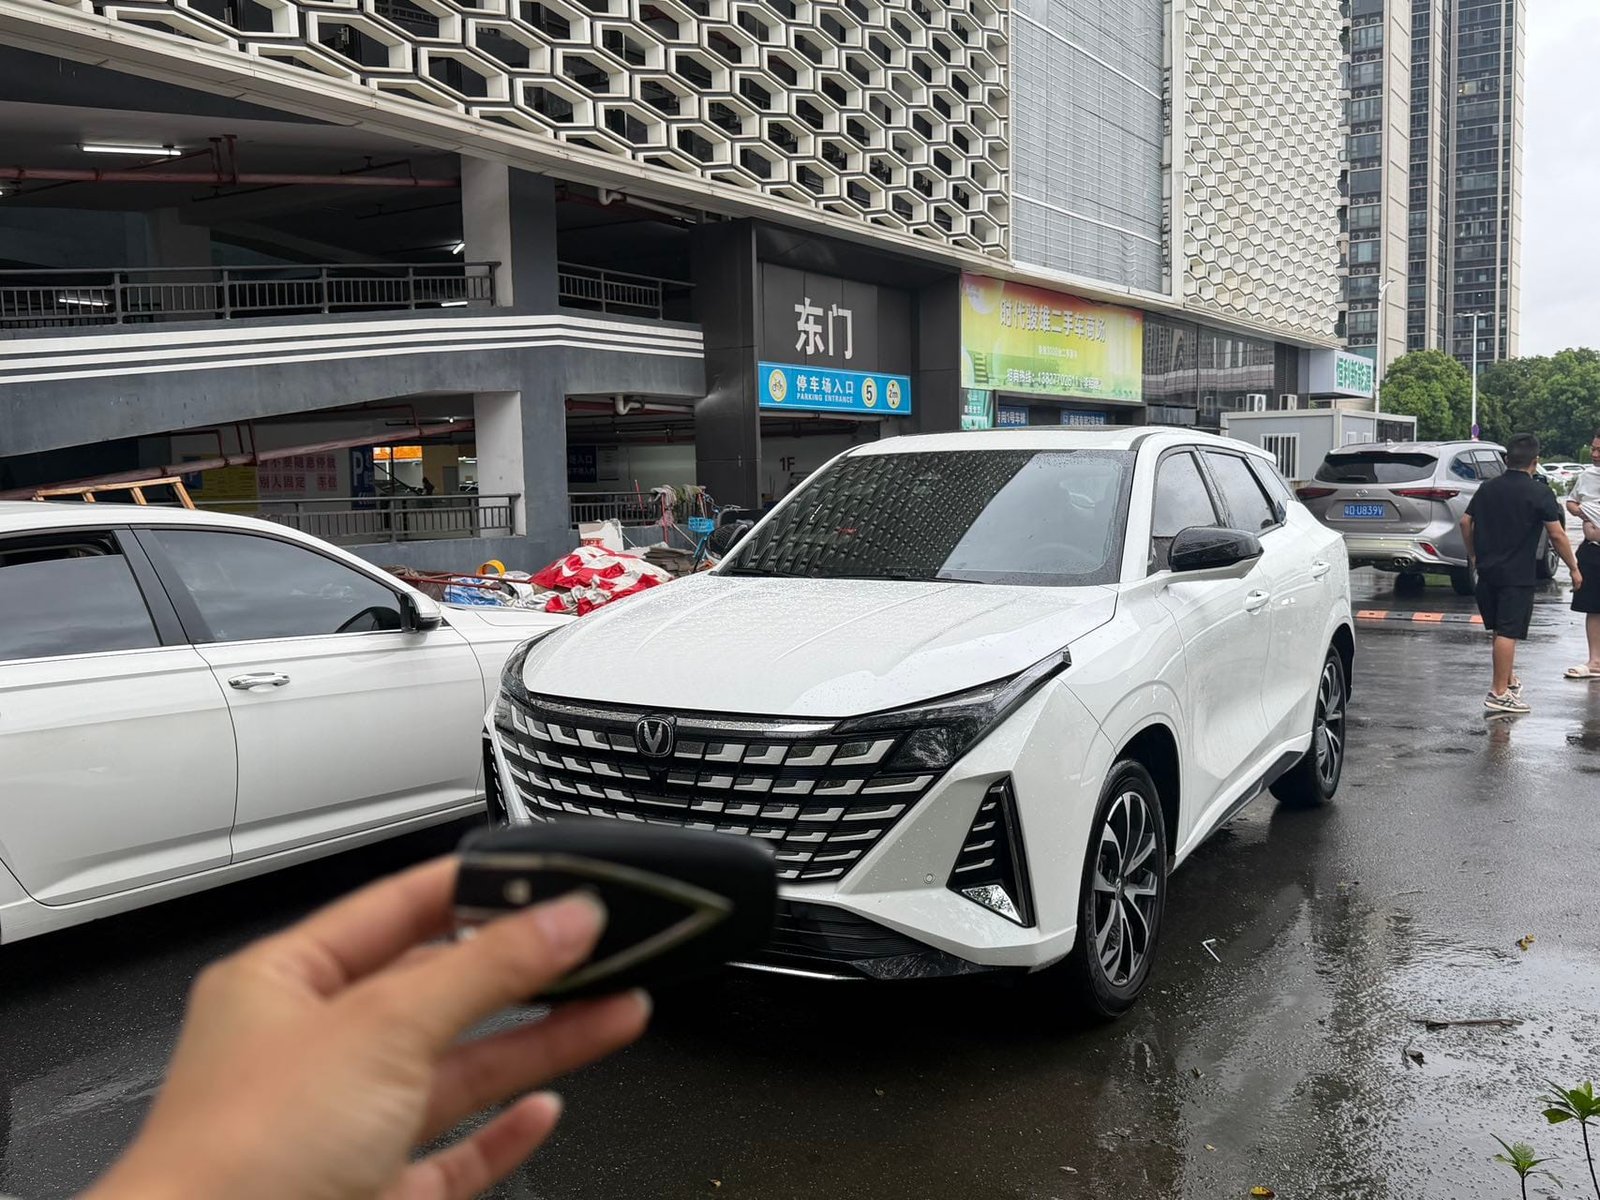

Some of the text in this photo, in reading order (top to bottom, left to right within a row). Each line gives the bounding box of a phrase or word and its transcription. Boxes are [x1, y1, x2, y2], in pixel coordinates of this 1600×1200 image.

[794, 297, 853, 360] 东门
[796, 374, 854, 395] 停车场入口
[796, 393, 854, 404] PARKING ENTRANCE
[866, 385, 873, 401] 5
[780, 457, 795, 471] 1F
